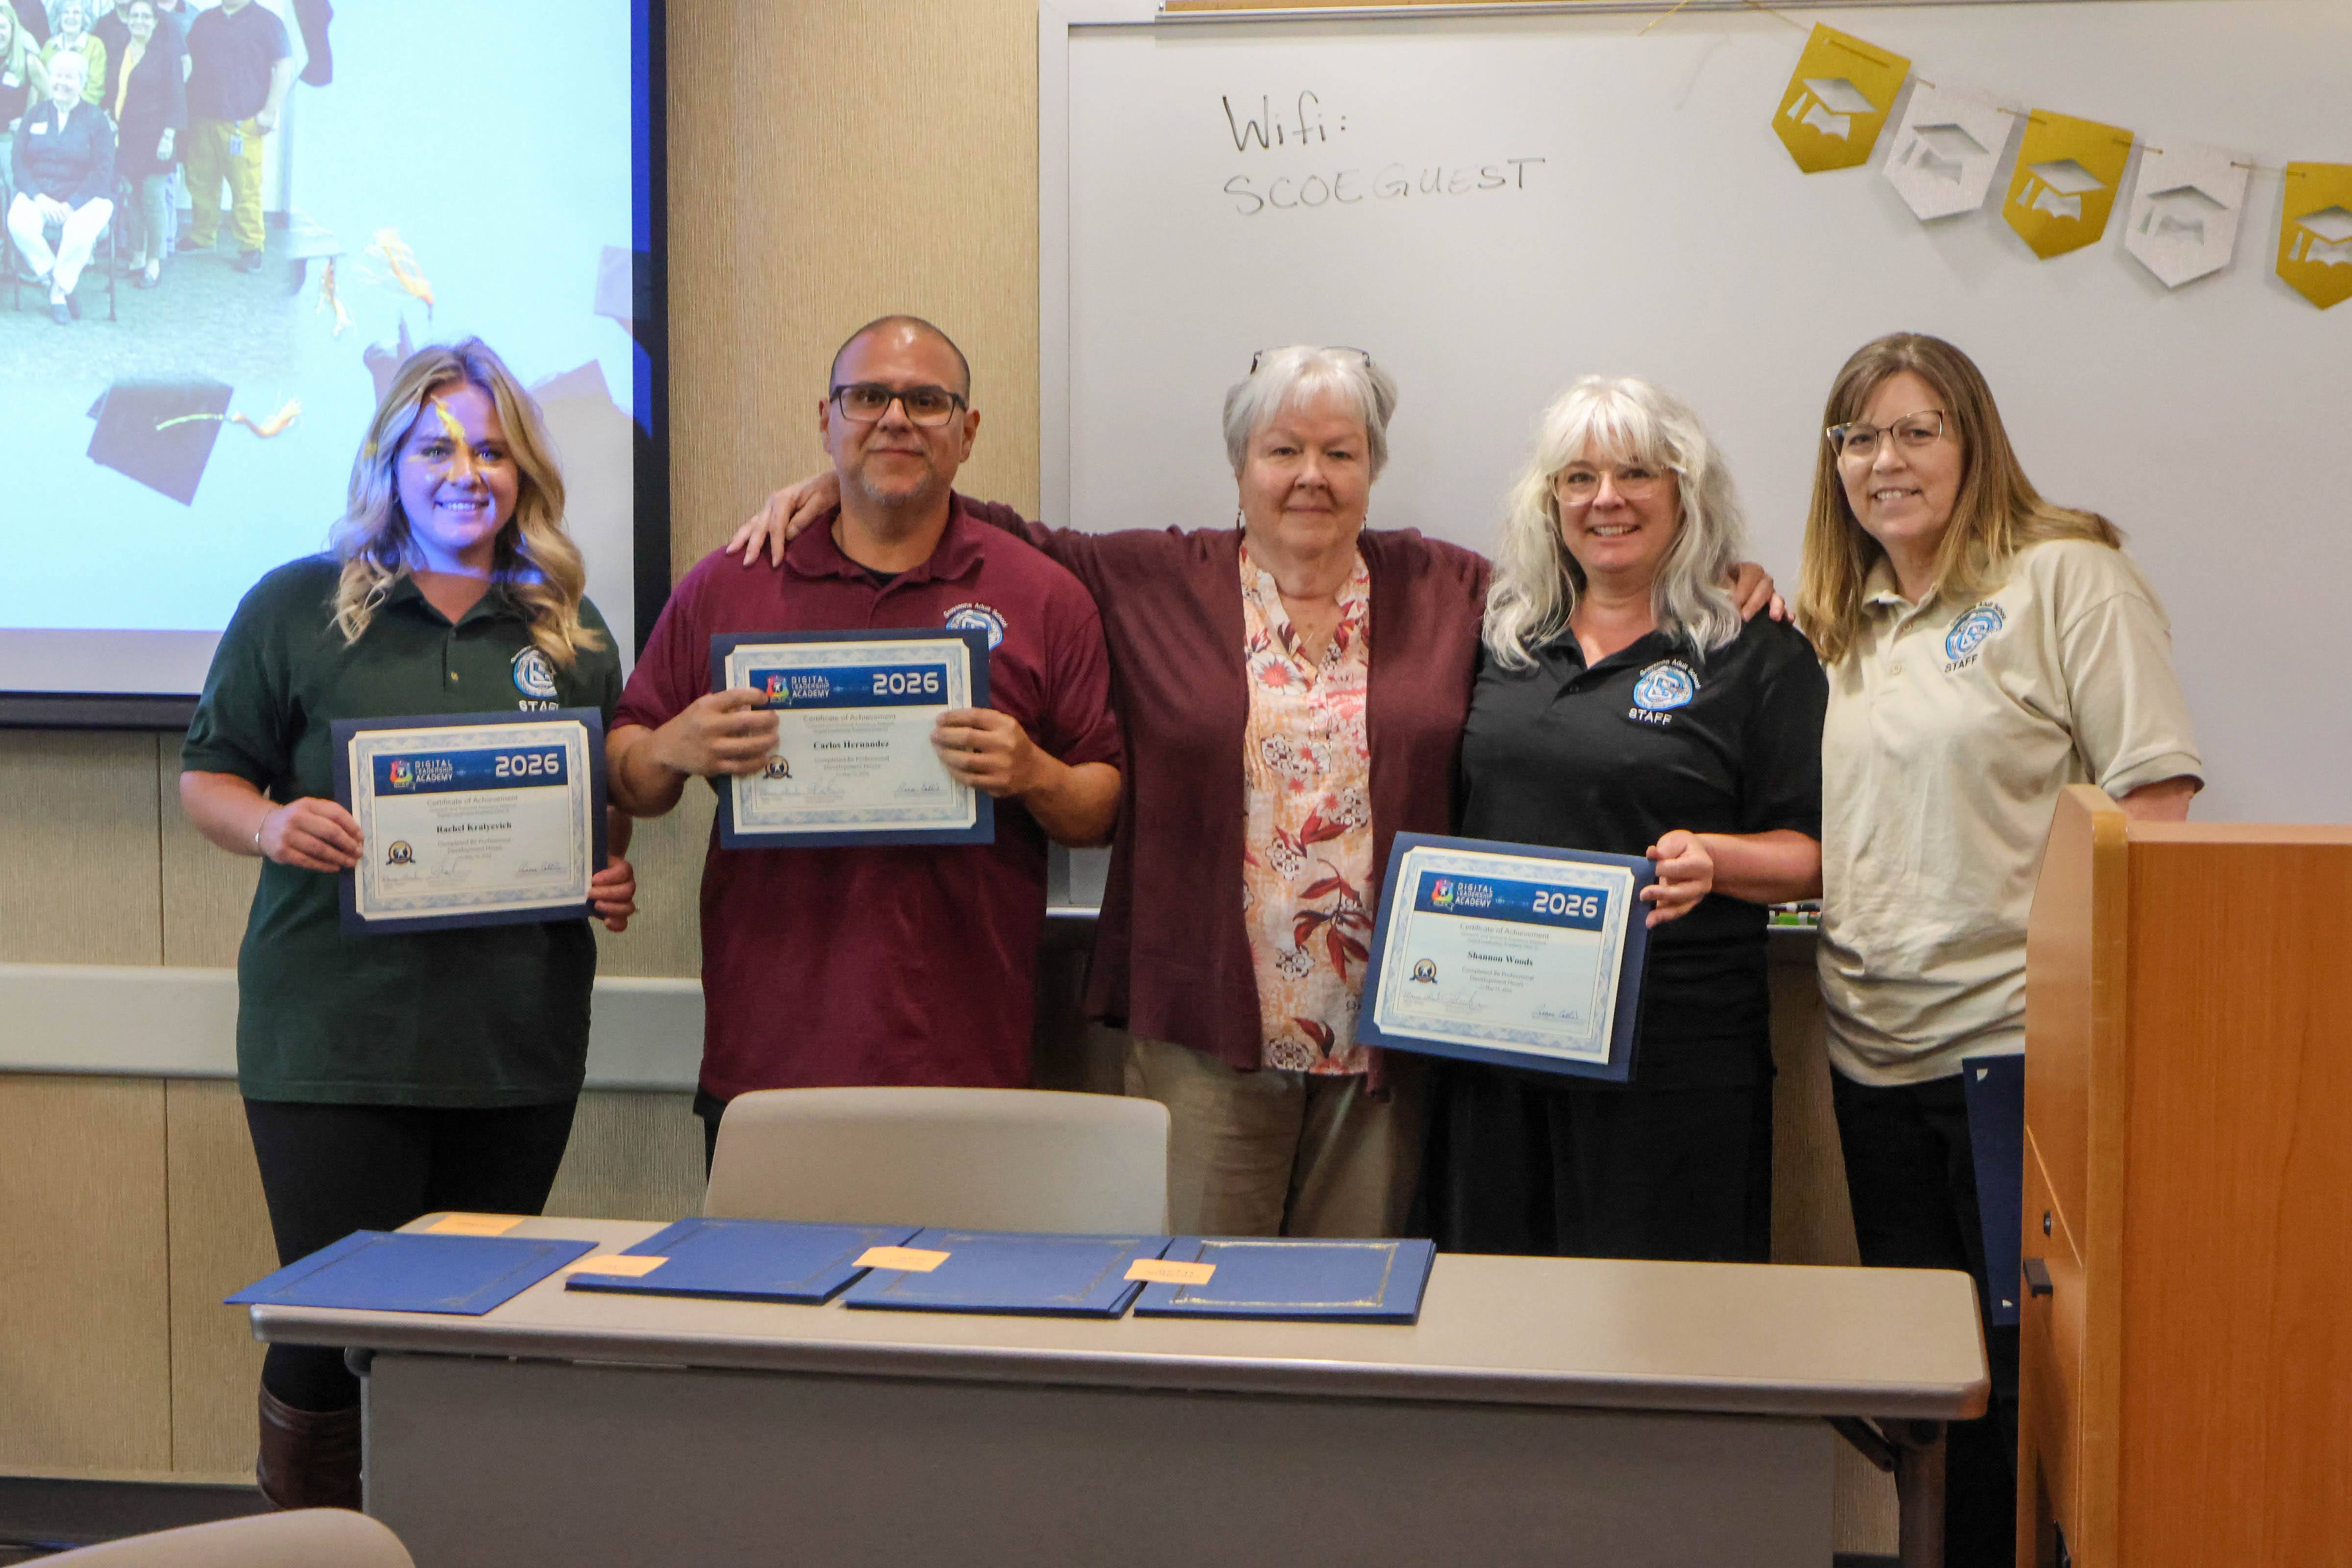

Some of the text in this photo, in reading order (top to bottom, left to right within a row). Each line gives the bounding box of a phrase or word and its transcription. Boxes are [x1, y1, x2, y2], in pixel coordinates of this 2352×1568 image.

[1223, 90, 1346, 152] Wifi:
[1945, 654, 1978, 672] STAFF
[873, 672, 938, 695] 2026
[792, 689, 829, 698] ACADEMY
[1629, 708, 1672, 725] STAFF
[813, 740, 889, 749] Carlos Hernandez
[415, 759, 453, 769] DIGITAL
[495, 753, 559, 777] 2026
[416, 773, 452, 783] ACADEMY
[437, 824, 464, 833] Rachel
[1457, 882, 1493, 892] DIGITAL
[1455, 897, 1491, 908] ACADEMY
[1532, 890, 1598, 919] 2026
[1468, 951, 1533, 966] Shannon Woods
